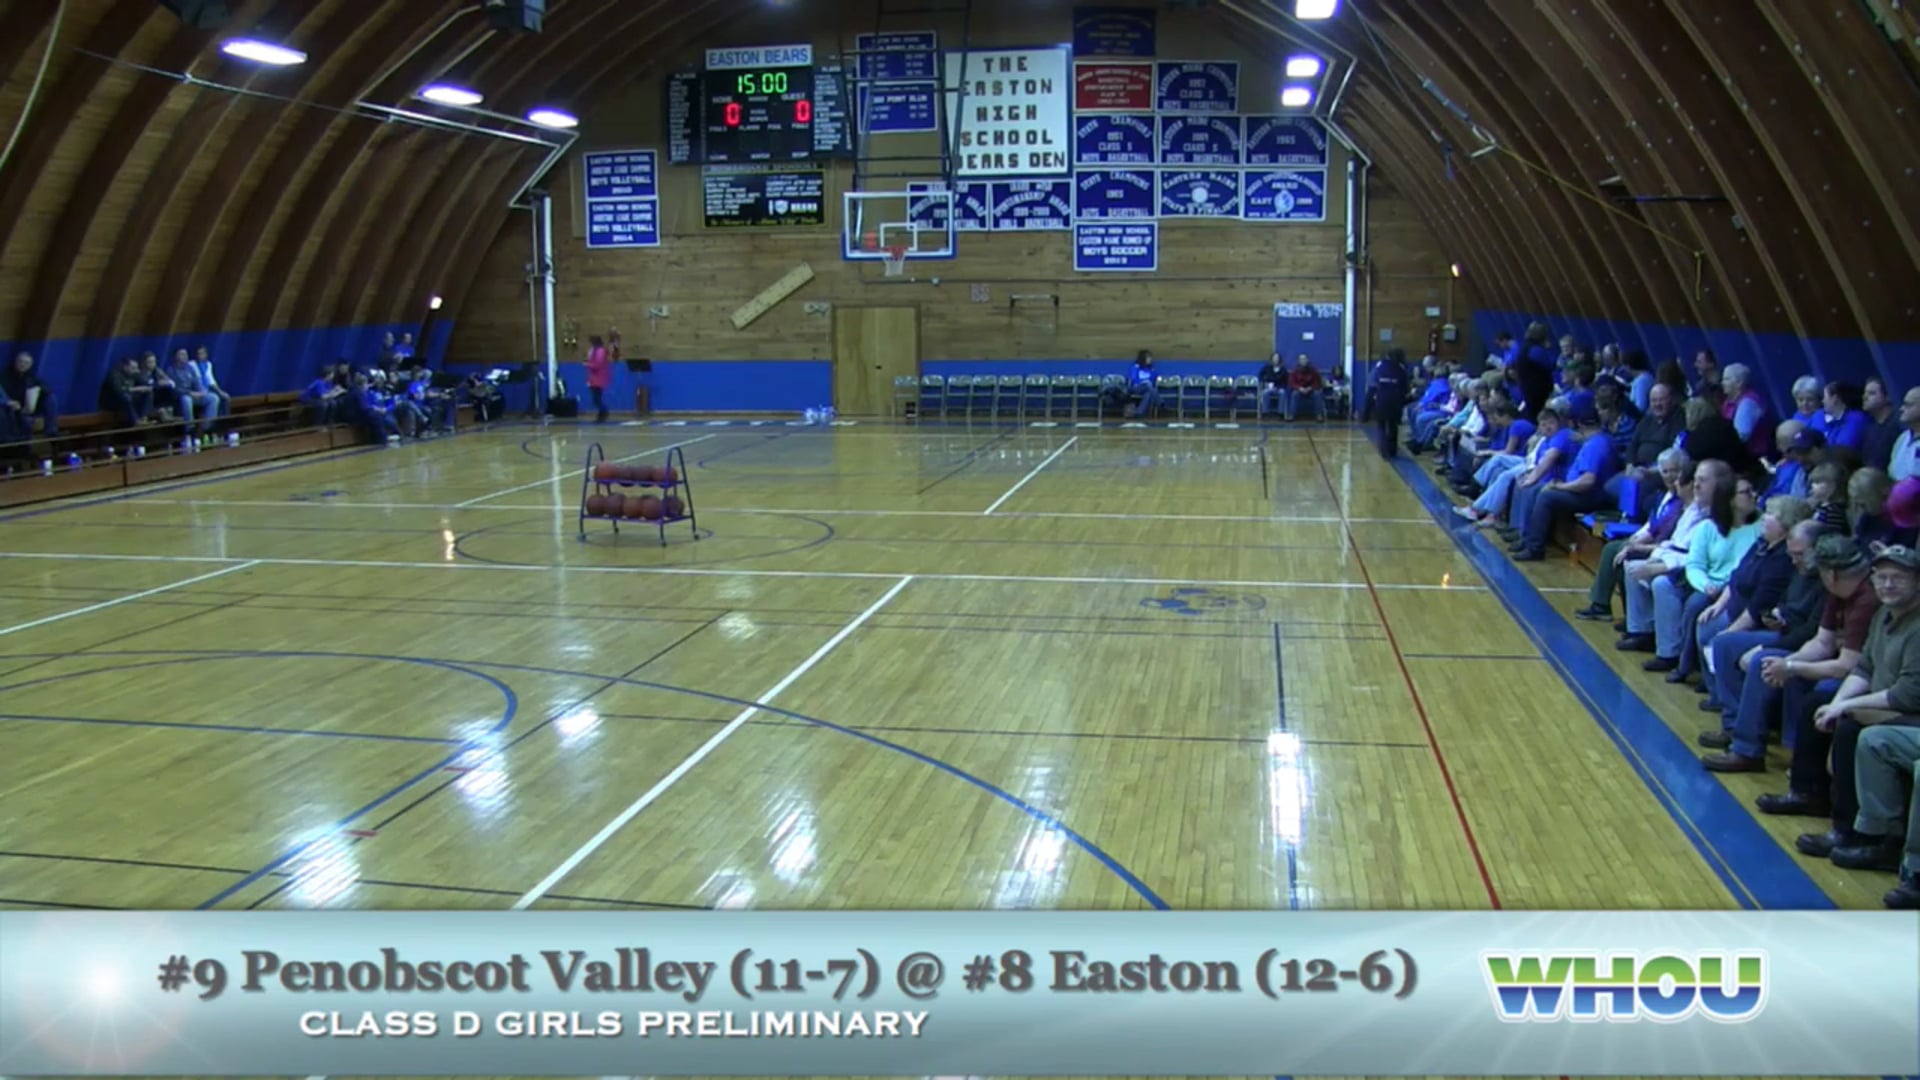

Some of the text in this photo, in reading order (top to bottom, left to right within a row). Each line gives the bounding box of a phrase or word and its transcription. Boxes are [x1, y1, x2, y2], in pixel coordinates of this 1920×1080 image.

[709, 48, 808, 66] EASTON BEARS
[983, 56, 1028, 73] THE
[960, 78, 1053, 96] EASTON
[725, 102, 741, 126] 0
[796, 99, 811, 123] 0
[976, 104, 1037, 122] HIGH
[961, 130, 1053, 147] SCHOOL
[1029, 151, 1065, 168] DEN
[611, 175, 652, 184] VOLLEYBALL
[1163, 172, 1236, 190] EASTERN MAINE
[1251, 197, 1273, 205] EAST
[592, 223, 654, 233] BOYS VOLLEYBALL
[1080, 227, 1106, 235] EASTON
[1083, 246, 1147, 255] BOYS SOCCER
